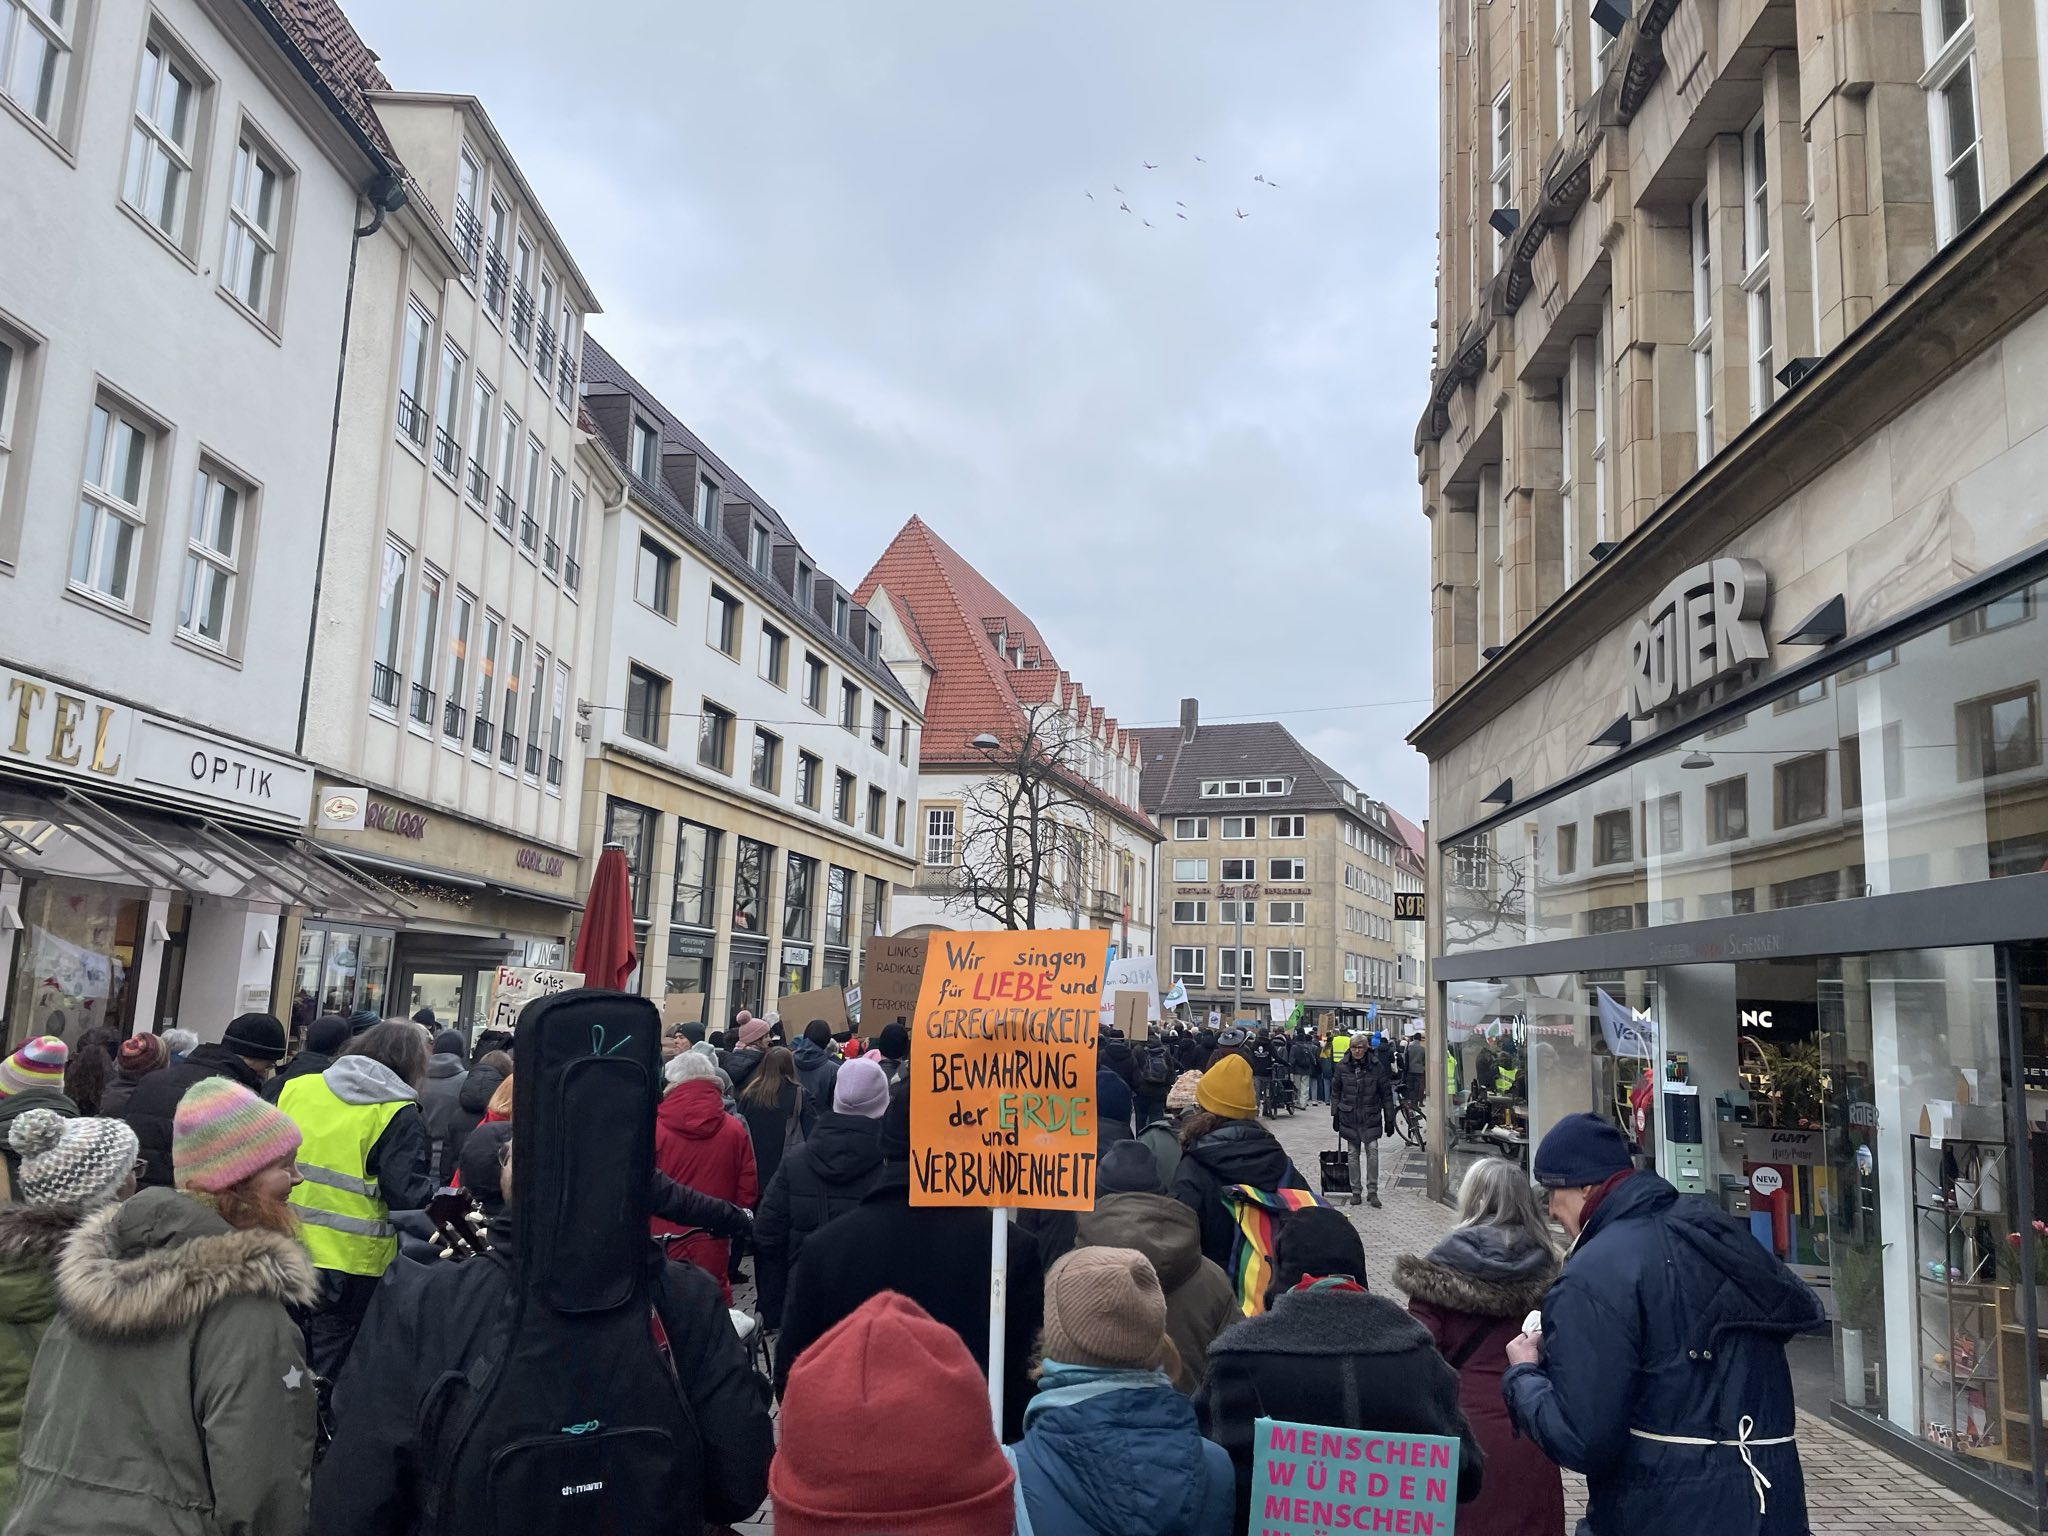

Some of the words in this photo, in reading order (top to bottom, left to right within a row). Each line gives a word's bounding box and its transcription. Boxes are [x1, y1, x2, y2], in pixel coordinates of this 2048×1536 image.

[1628, 557, 1768, 721] RÜTER
[190, 751, 273, 798] OPTIK
[1396, 895, 1424, 917] SØR
[876, 963, 921, 975] RADIKALE
[887, 946, 925, 958] LINKS-
[946, 941, 985, 972] Wir
[1014, 948, 1086, 981] singen
[499, 968, 523, 989] Für:
[534, 972, 564, 989] Gutes
[939, 979, 965, 1006] für
[973, 971, 1054, 1001] LIEBE
[1060, 976, 1098, 995] und
[495, 1003, 517, 1027] Fü
[926, 1008, 1097, 1049] GERECHTIGKEIT,
[1741, 1010, 1773, 1028] NC
[930, 1050, 1078, 1093] BEWAHRUNG
[949, 1100, 989, 1126] der
[999, 1093, 1091, 1136] ERDE
[982, 1115, 1019, 1147] und
[1771, 1132, 1812, 1144] LAMY
[912, 1147, 1095, 1199] VERBUNDENHEIT
[1756, 1174, 1778, 1184] NEW
[1270, 1426, 1450, 1469] MENSCHEN
[1268, 1460, 1447, 1503] WÜRDEN
[1264, 1495, 1446, 1536] MENSCHEN-
